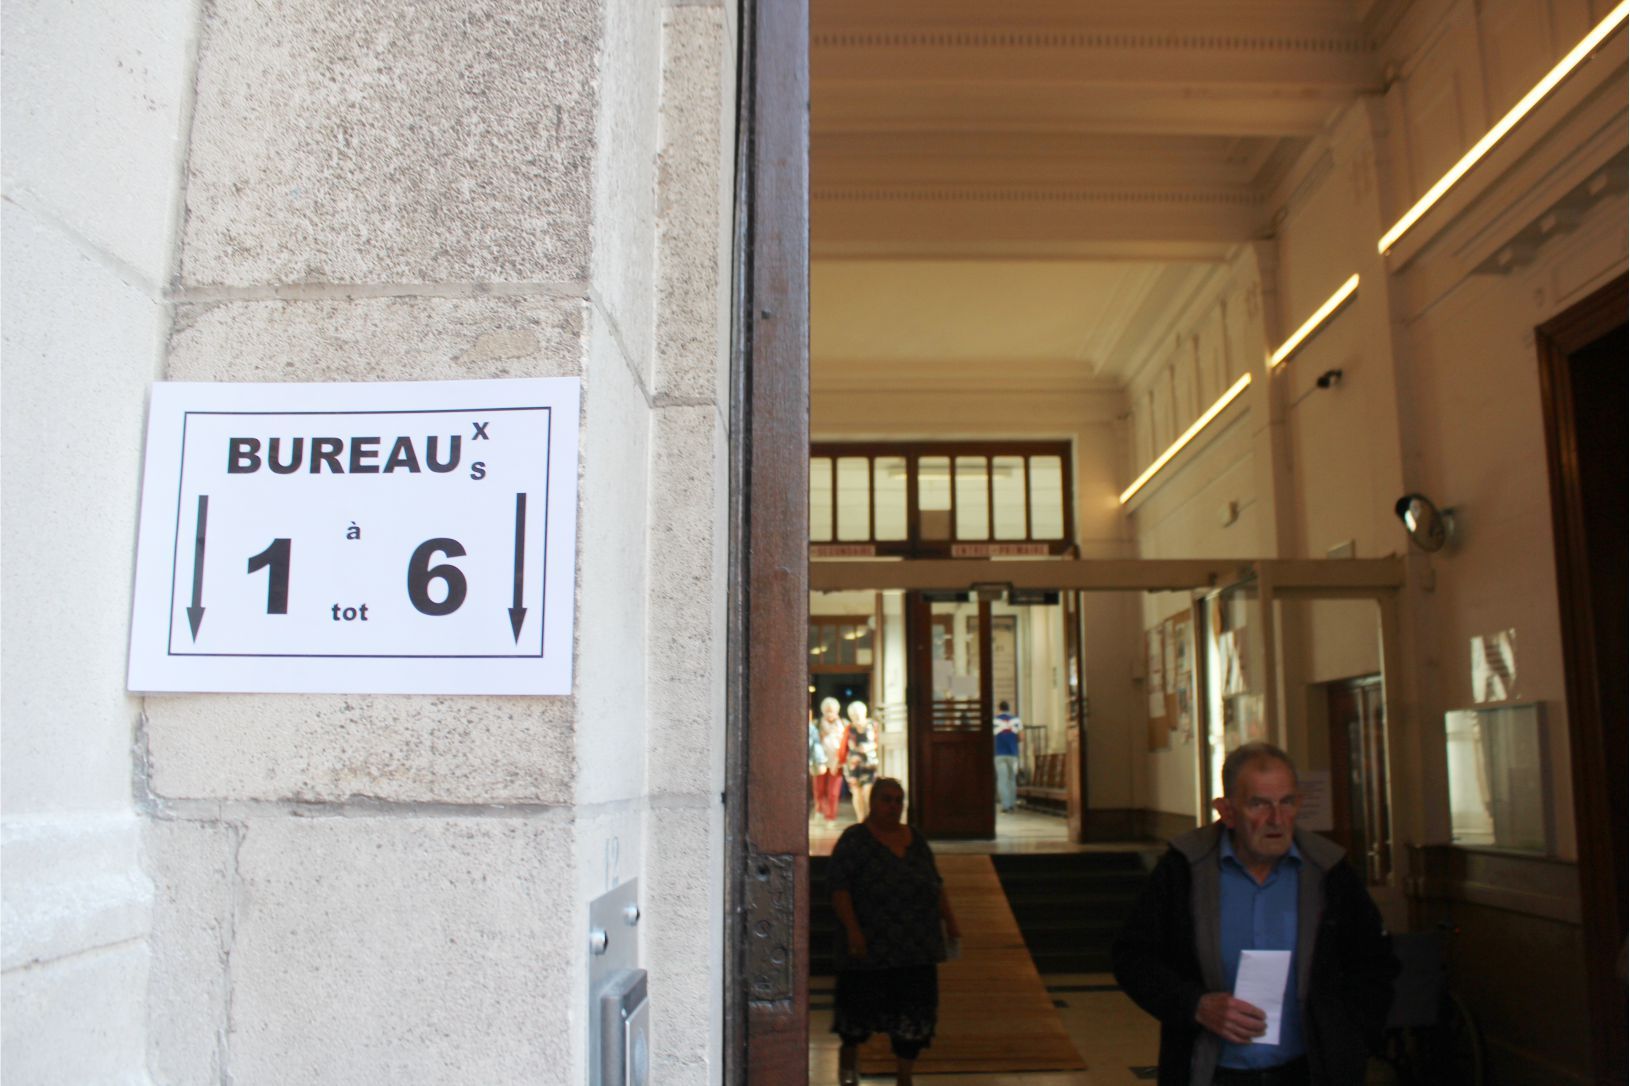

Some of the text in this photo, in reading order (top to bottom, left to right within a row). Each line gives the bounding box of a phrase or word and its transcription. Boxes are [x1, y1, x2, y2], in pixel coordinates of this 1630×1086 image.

[227, 435, 462, 475] BUREAU
[346, 521, 361, 540] à
[247, 537, 468, 617] 1 6
[331, 603, 369, 621] tot
